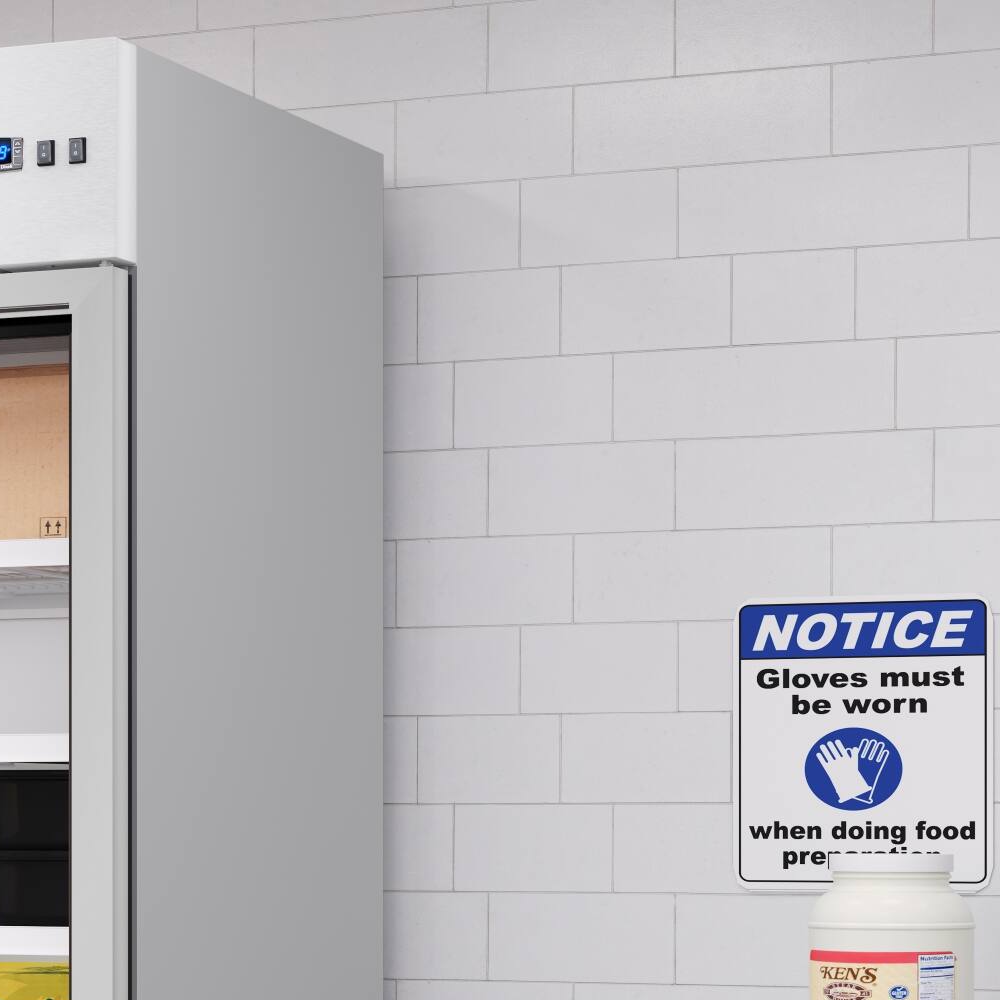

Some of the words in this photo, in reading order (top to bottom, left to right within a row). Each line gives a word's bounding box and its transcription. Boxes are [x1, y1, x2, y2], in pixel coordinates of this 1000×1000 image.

[752, 610, 973, 651] NOTICE
[756, 668, 868, 689] Gloves
[880, 666, 965, 687] must
[791, 694, 831, 714] be
[842, 697, 928, 714] worn
[749, 821, 822, 840] when
[831, 821, 907, 844] doing
[915, 821, 976, 840] food
[820, 966, 878, 983] KEN'S
